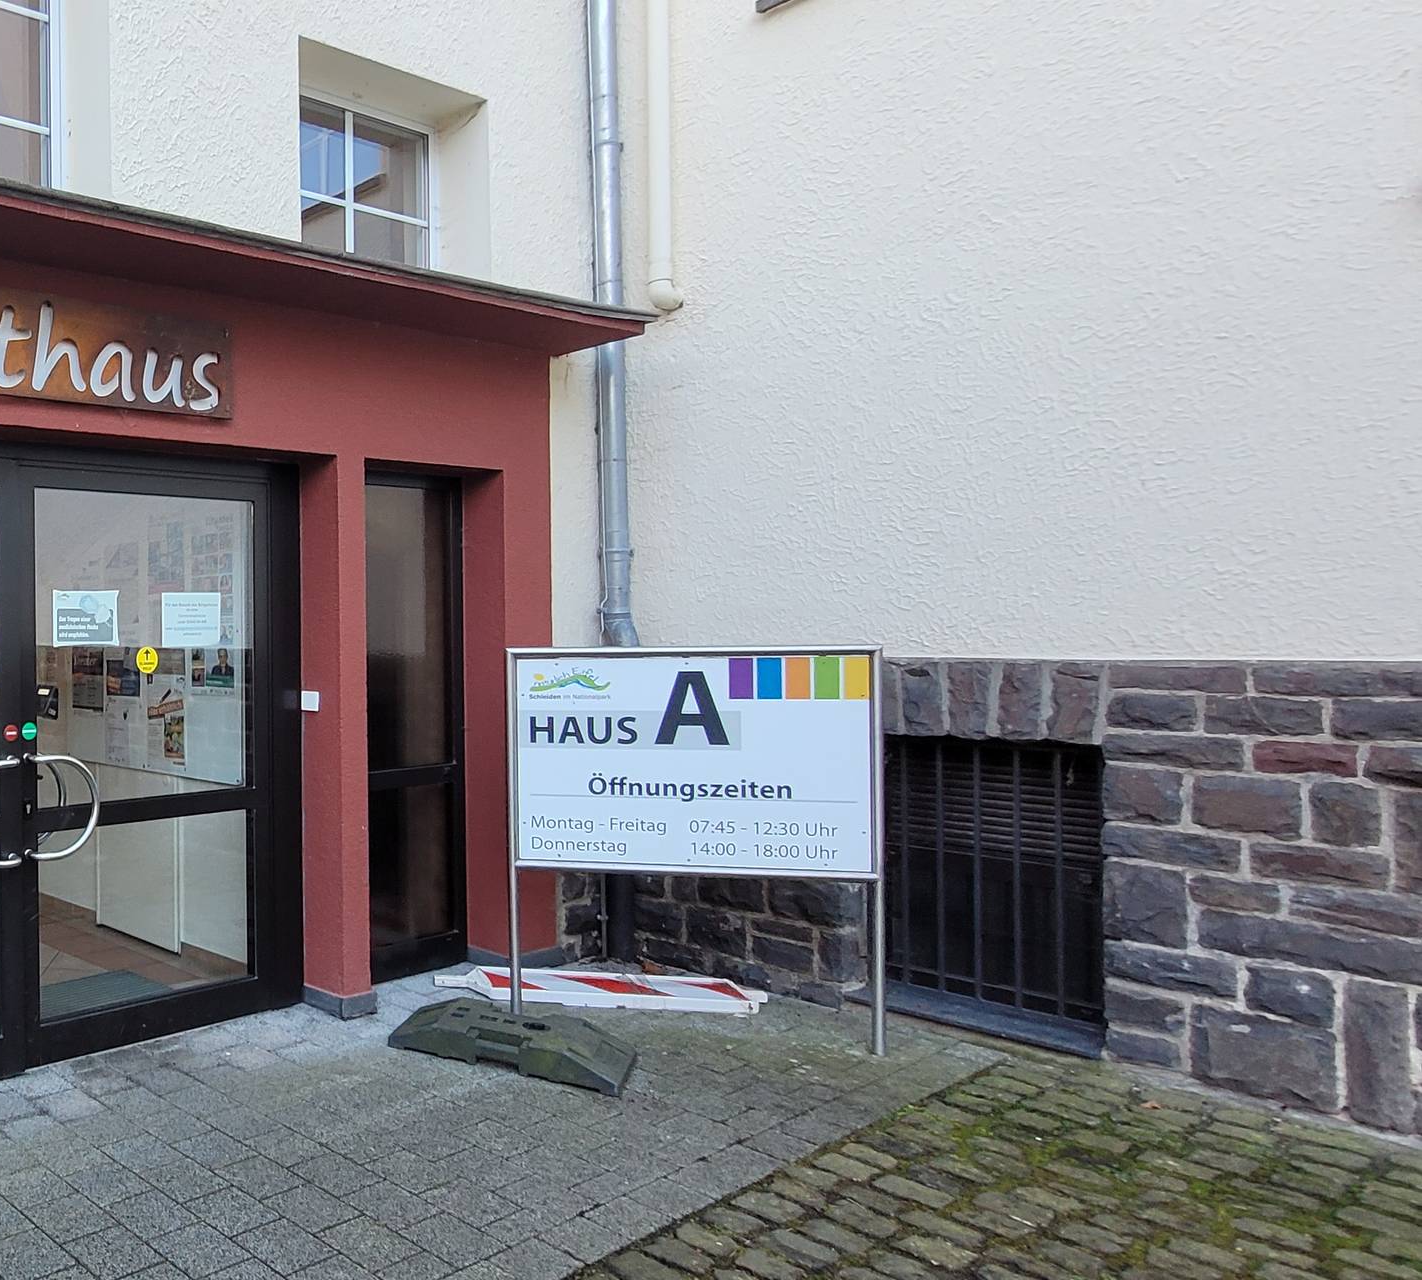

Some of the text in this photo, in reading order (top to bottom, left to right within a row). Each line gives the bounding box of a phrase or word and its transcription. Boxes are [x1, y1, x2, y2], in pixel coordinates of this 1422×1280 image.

[572, 693, 611, 701] Nationalpark
[530, 671, 730, 745] HAUS A
[588, 772, 792, 802] Öffnungszeiten
[530, 815, 594, 833] Montag
[609, 817, 667, 835] Freitag
[689, 819, 736, 834] 07:45
[753, 821, 800, 836] 12:30
[805, 822, 838, 837] Uhr
[531, 836, 627, 856] Donnerstag
[691, 842, 736, 856] 14:00
[753, 844, 800, 858] 18:00
[805, 844, 838, 860] Uhr
